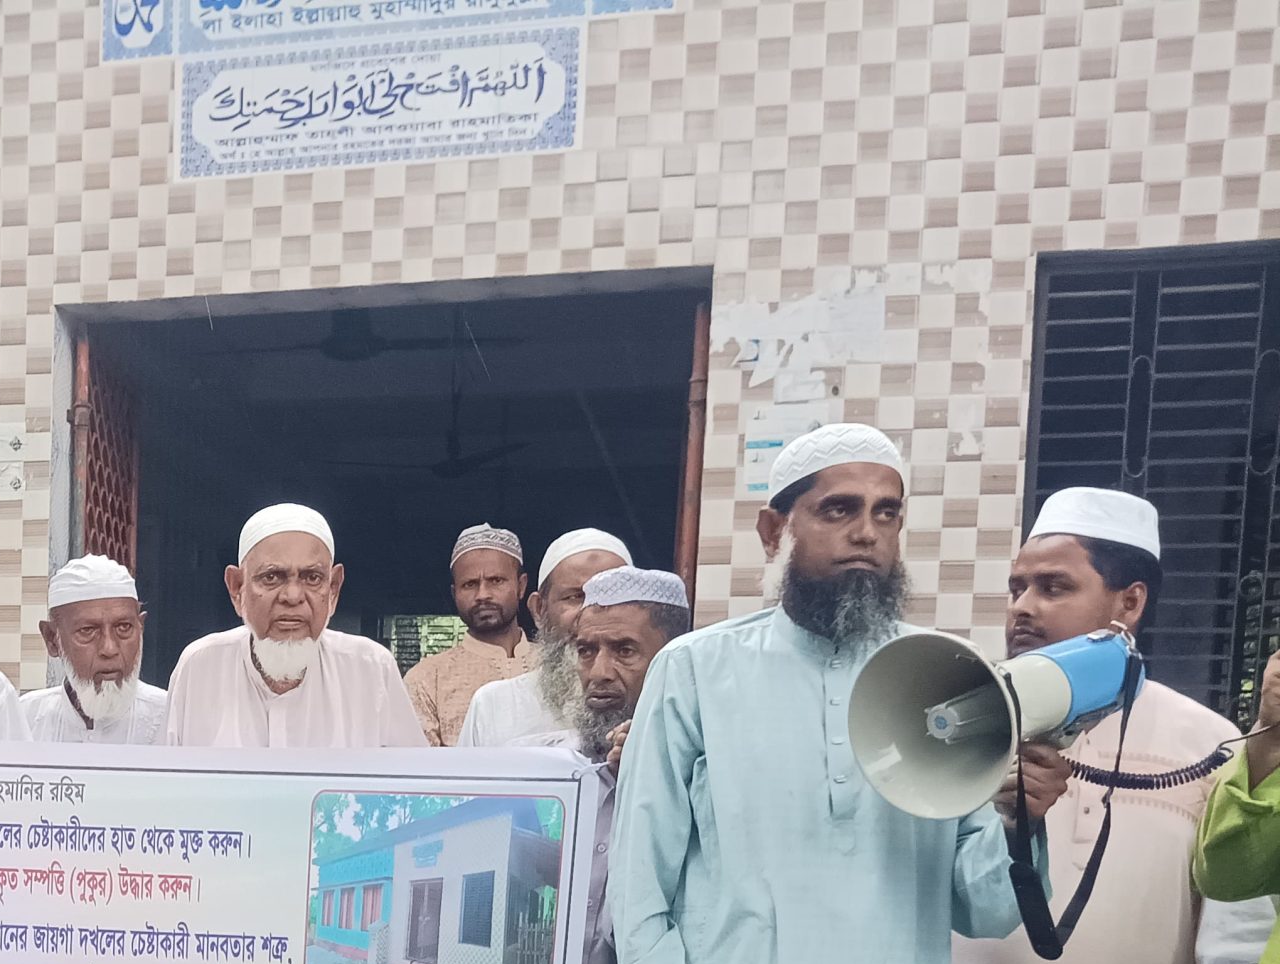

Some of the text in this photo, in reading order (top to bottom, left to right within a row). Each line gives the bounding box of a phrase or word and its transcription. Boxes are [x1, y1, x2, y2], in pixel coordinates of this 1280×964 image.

[50, 776, 85, 804] রহিম
[27, 815, 105, 854] চেষ্টাকারীদের
[110, 824, 135, 856] হাত
[141, 826, 174, 856] থেকে
[179, 828, 203, 863] মুক্ত
[23, 861, 65, 897] সম্পত্তি
[70, 866, 112, 905] (পুকুর)
[118, 864, 153, 900] উদ্ধার
[32, 924, 73, 955] জায়গা
[79, 926, 126, 957] দখলের
[130, 921, 191, 959] চেষ্টাকারী
[194, 932, 255, 963] মানবতার
